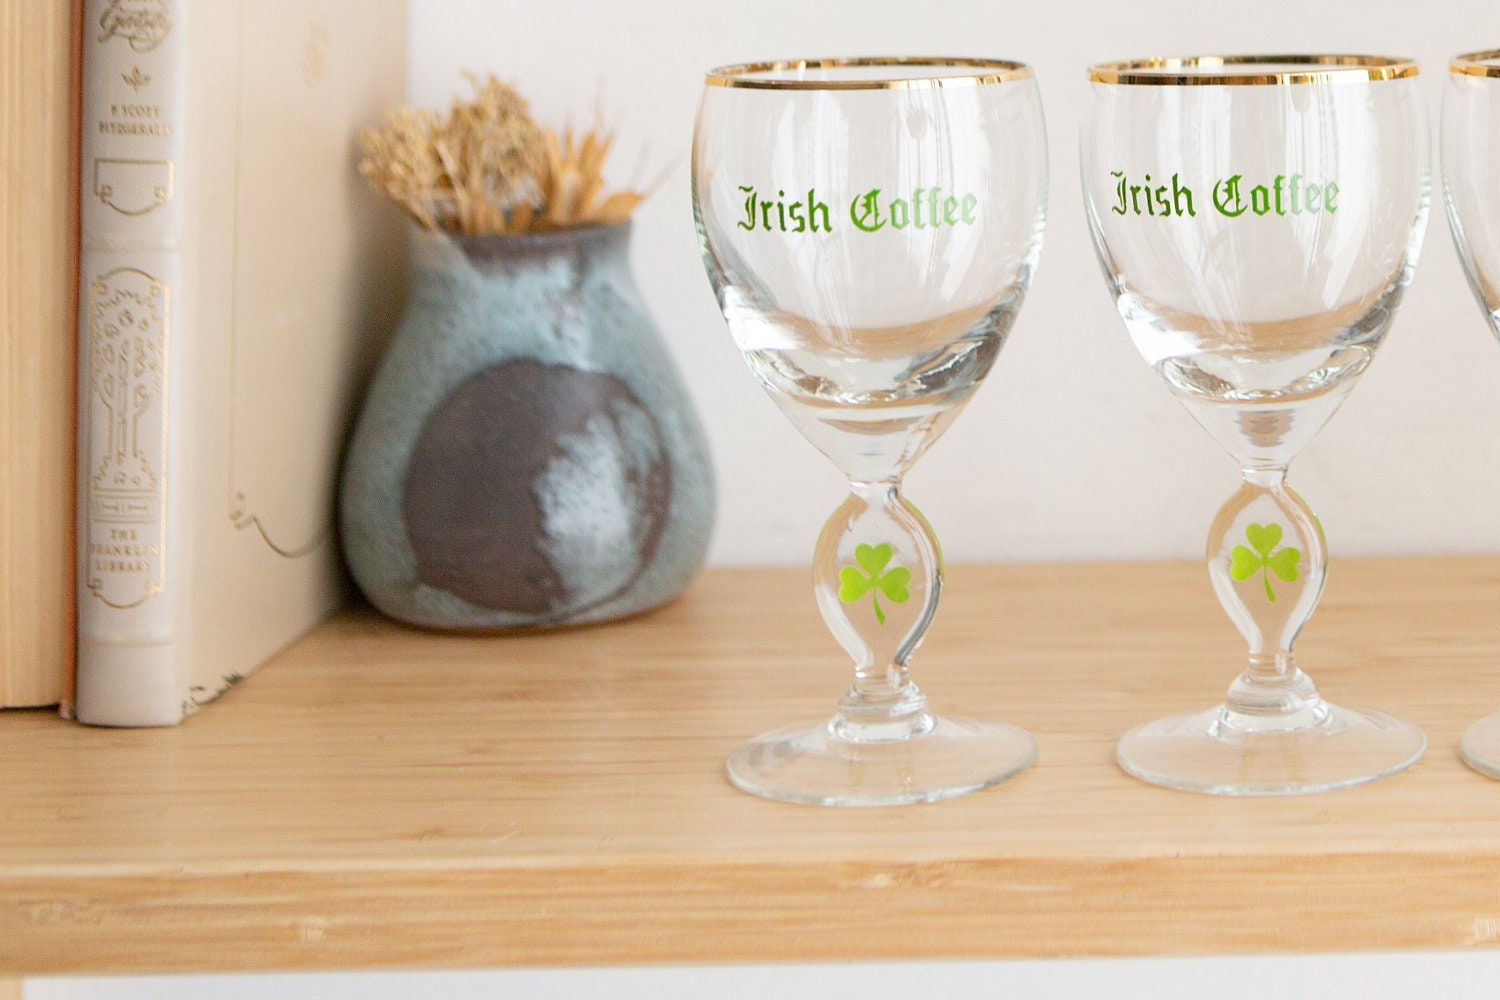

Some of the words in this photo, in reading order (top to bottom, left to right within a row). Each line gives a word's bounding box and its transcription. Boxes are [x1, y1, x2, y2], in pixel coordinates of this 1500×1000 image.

[737, 186, 833, 233] Irish
[850, 186, 978, 233] Coffee
[1110, 171, 1196, 217] Irish
[1212, 174, 1340, 218] Coffee
